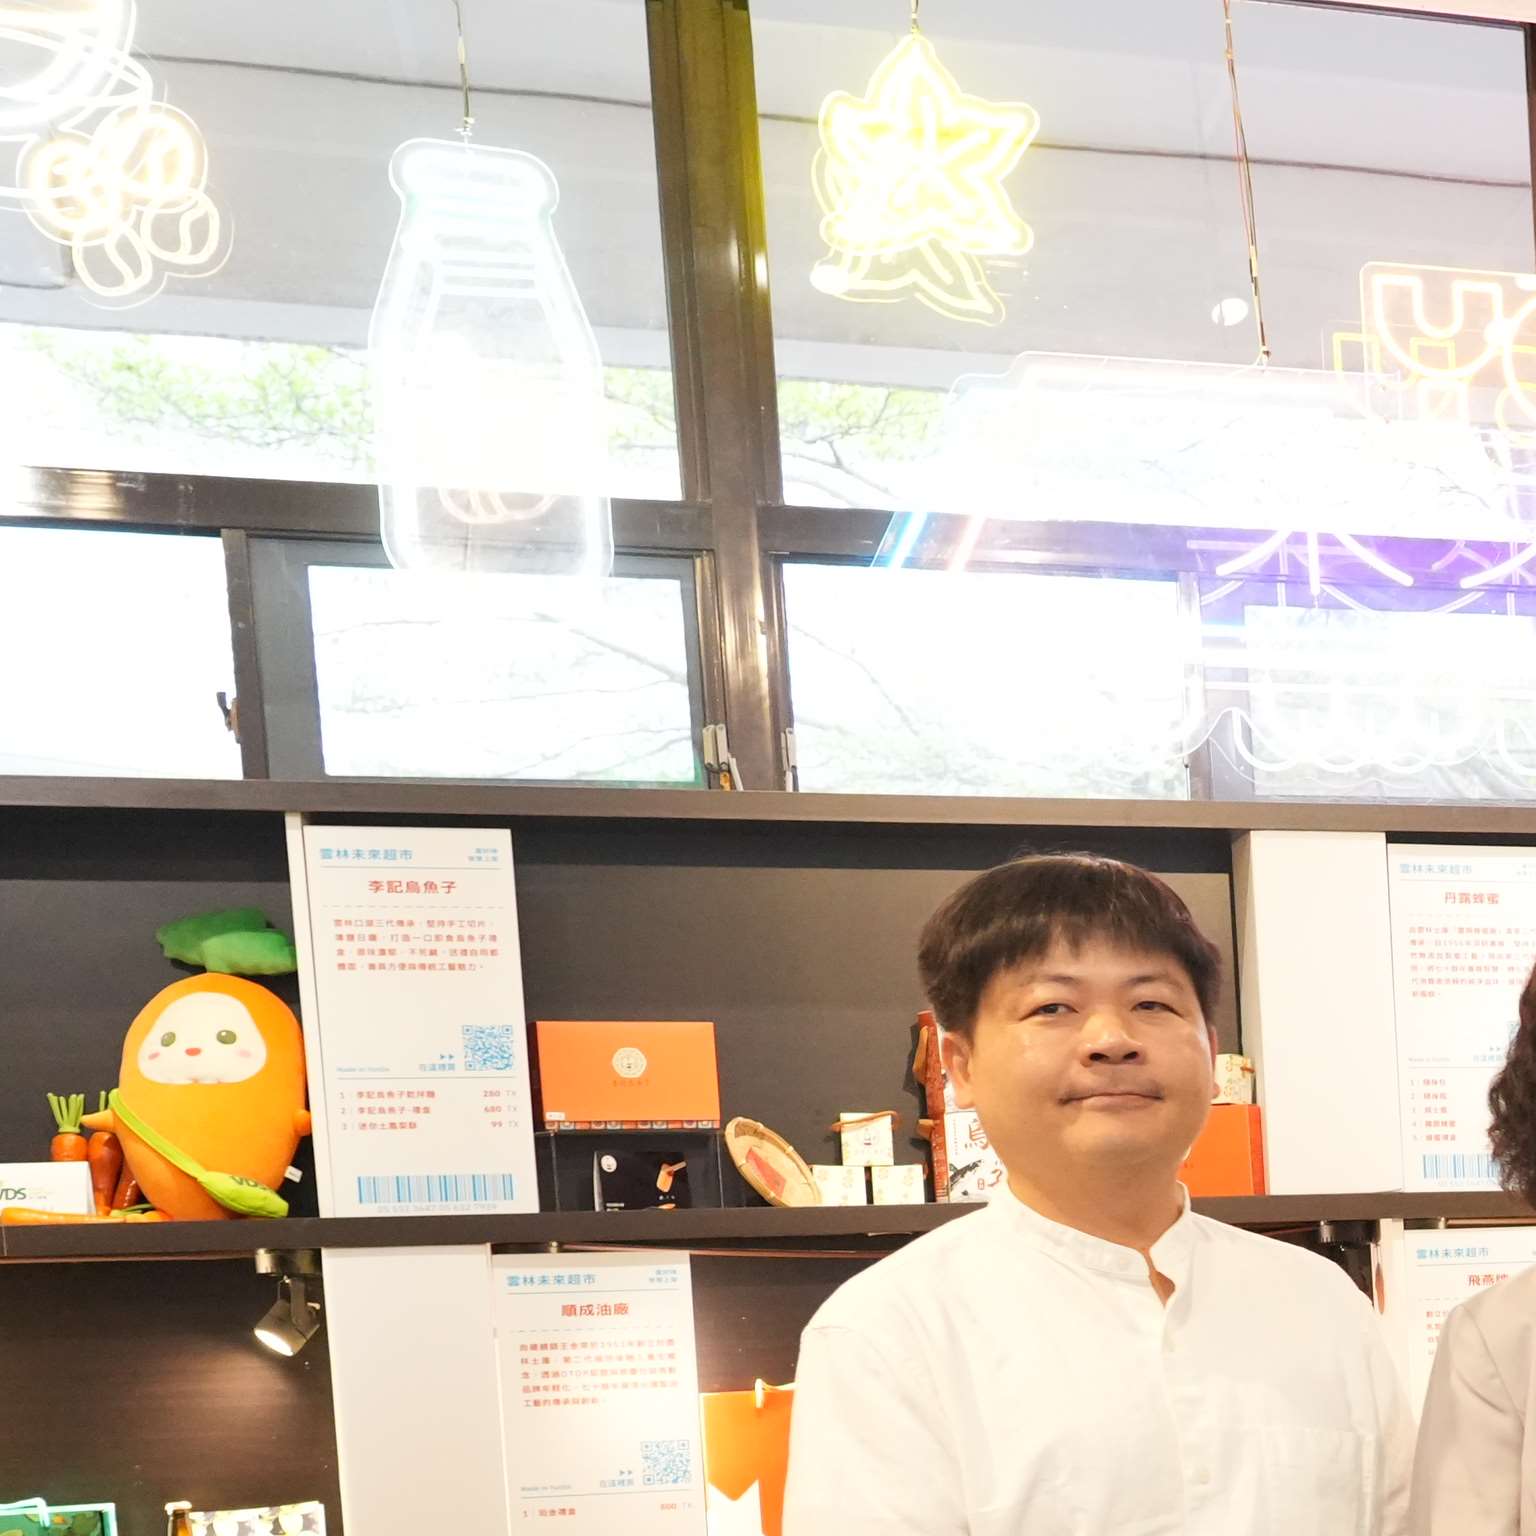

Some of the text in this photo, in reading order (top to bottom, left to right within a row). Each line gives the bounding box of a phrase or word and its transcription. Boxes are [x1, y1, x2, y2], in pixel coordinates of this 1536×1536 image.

[320, 847, 414, 861] 雲林未來超市
[1400, 863, 1473, 874] 雲林未來超市
[368, 880, 457, 894] 李記烏魚子
[1416, 1247, 1489, 1259] 雲林未來超市
[506, 1274, 595, 1286] 雲林未來超市
[561, 1303, 629, 1317] 順成油廠
